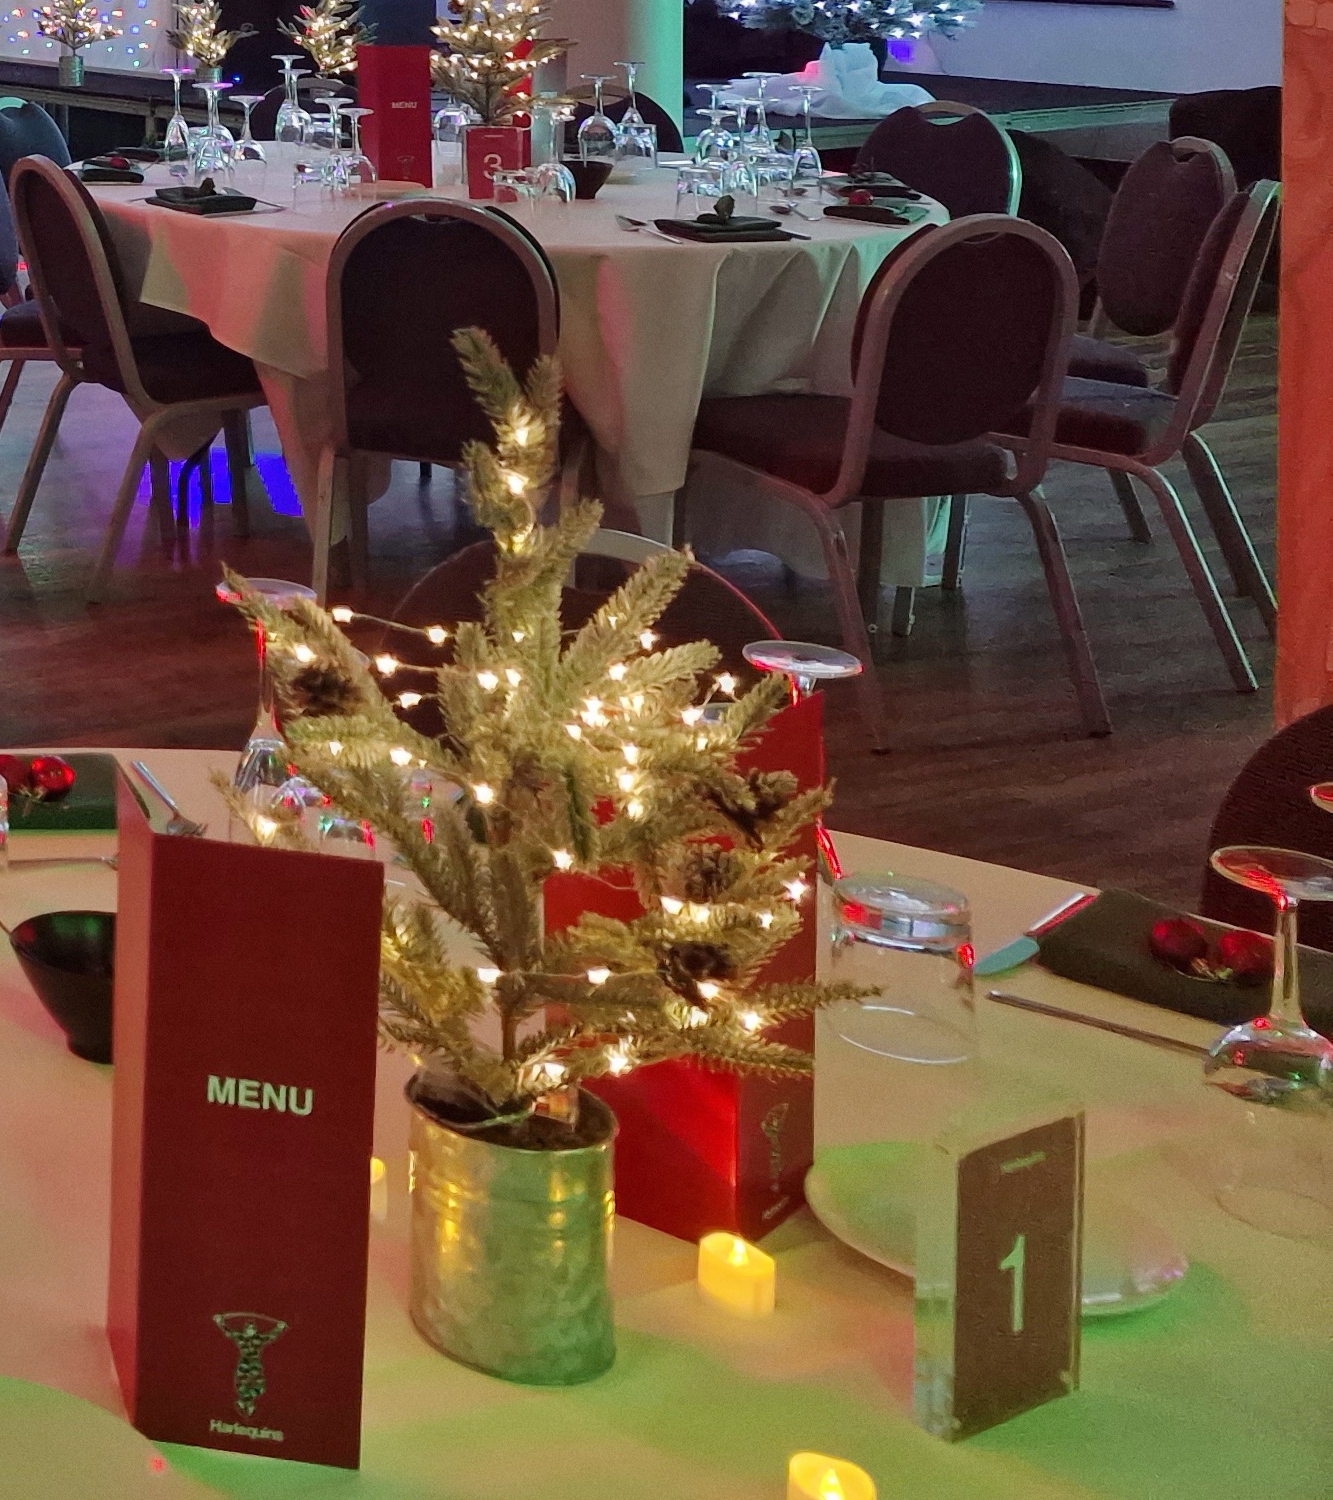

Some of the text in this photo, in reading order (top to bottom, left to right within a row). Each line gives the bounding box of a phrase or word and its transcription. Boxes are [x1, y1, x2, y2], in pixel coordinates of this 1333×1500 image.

[483, 153, 502, 180] 3
[207, 1074, 313, 1116] MENU
[998, 1234, 1026, 1333] 1
